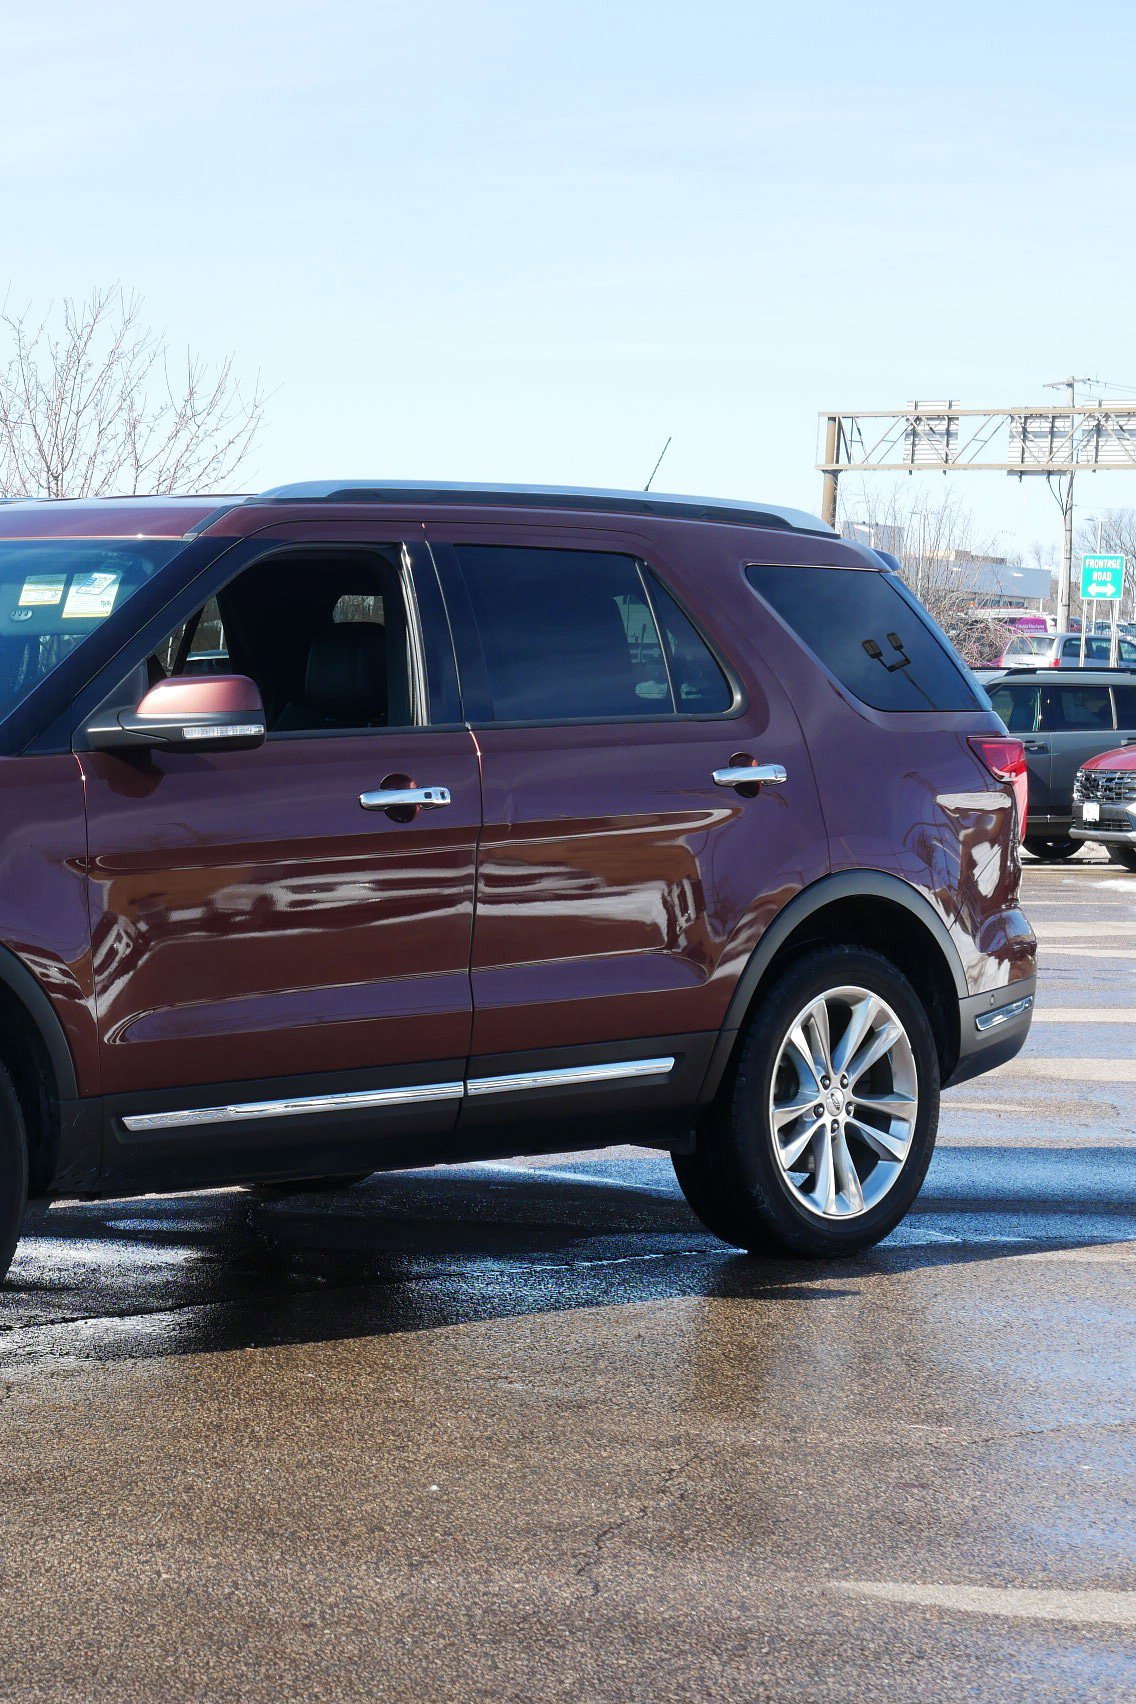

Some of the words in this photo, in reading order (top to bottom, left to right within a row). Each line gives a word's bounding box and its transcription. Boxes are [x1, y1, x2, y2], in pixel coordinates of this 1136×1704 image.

[1086, 559, 1121, 569] FRONTAGE
[1092, 571, 1112, 581] ROAD
[130, 1110, 225, 1127] EXPLORER
